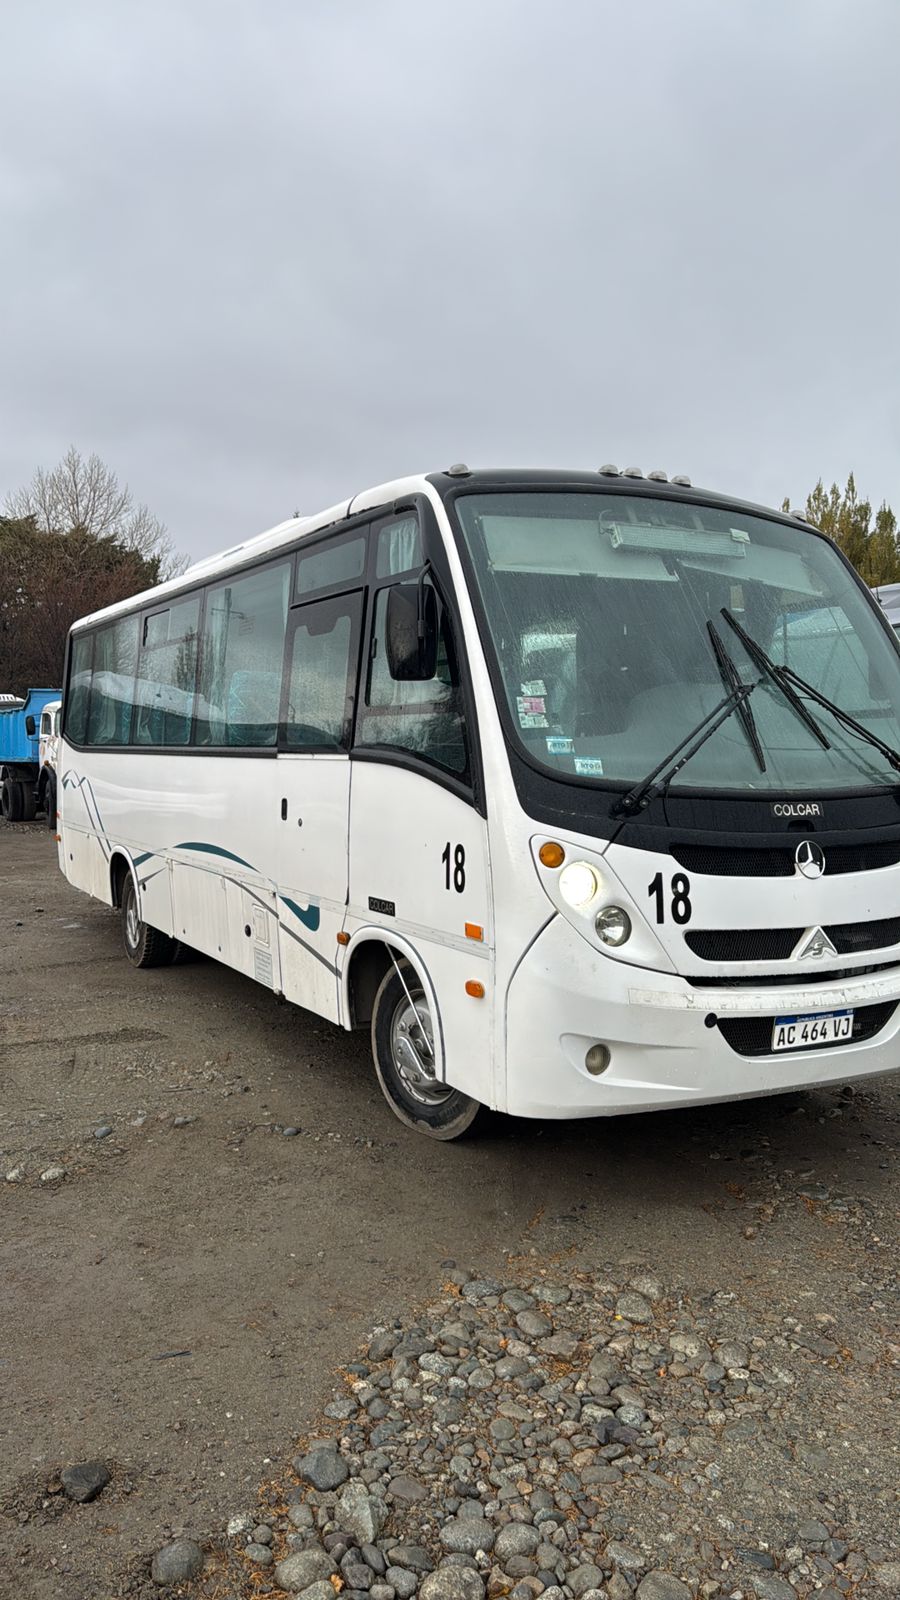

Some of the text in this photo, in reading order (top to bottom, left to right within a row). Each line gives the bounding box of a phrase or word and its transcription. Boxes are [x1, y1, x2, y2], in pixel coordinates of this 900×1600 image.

[773, 804, 820, 816] COLCAR
[442, 842, 466, 893] 18
[369, 899, 394, 915] COLCAR
[648, 872, 692, 925] 18
[777, 1018, 850, 1046] AC 464 VJ
